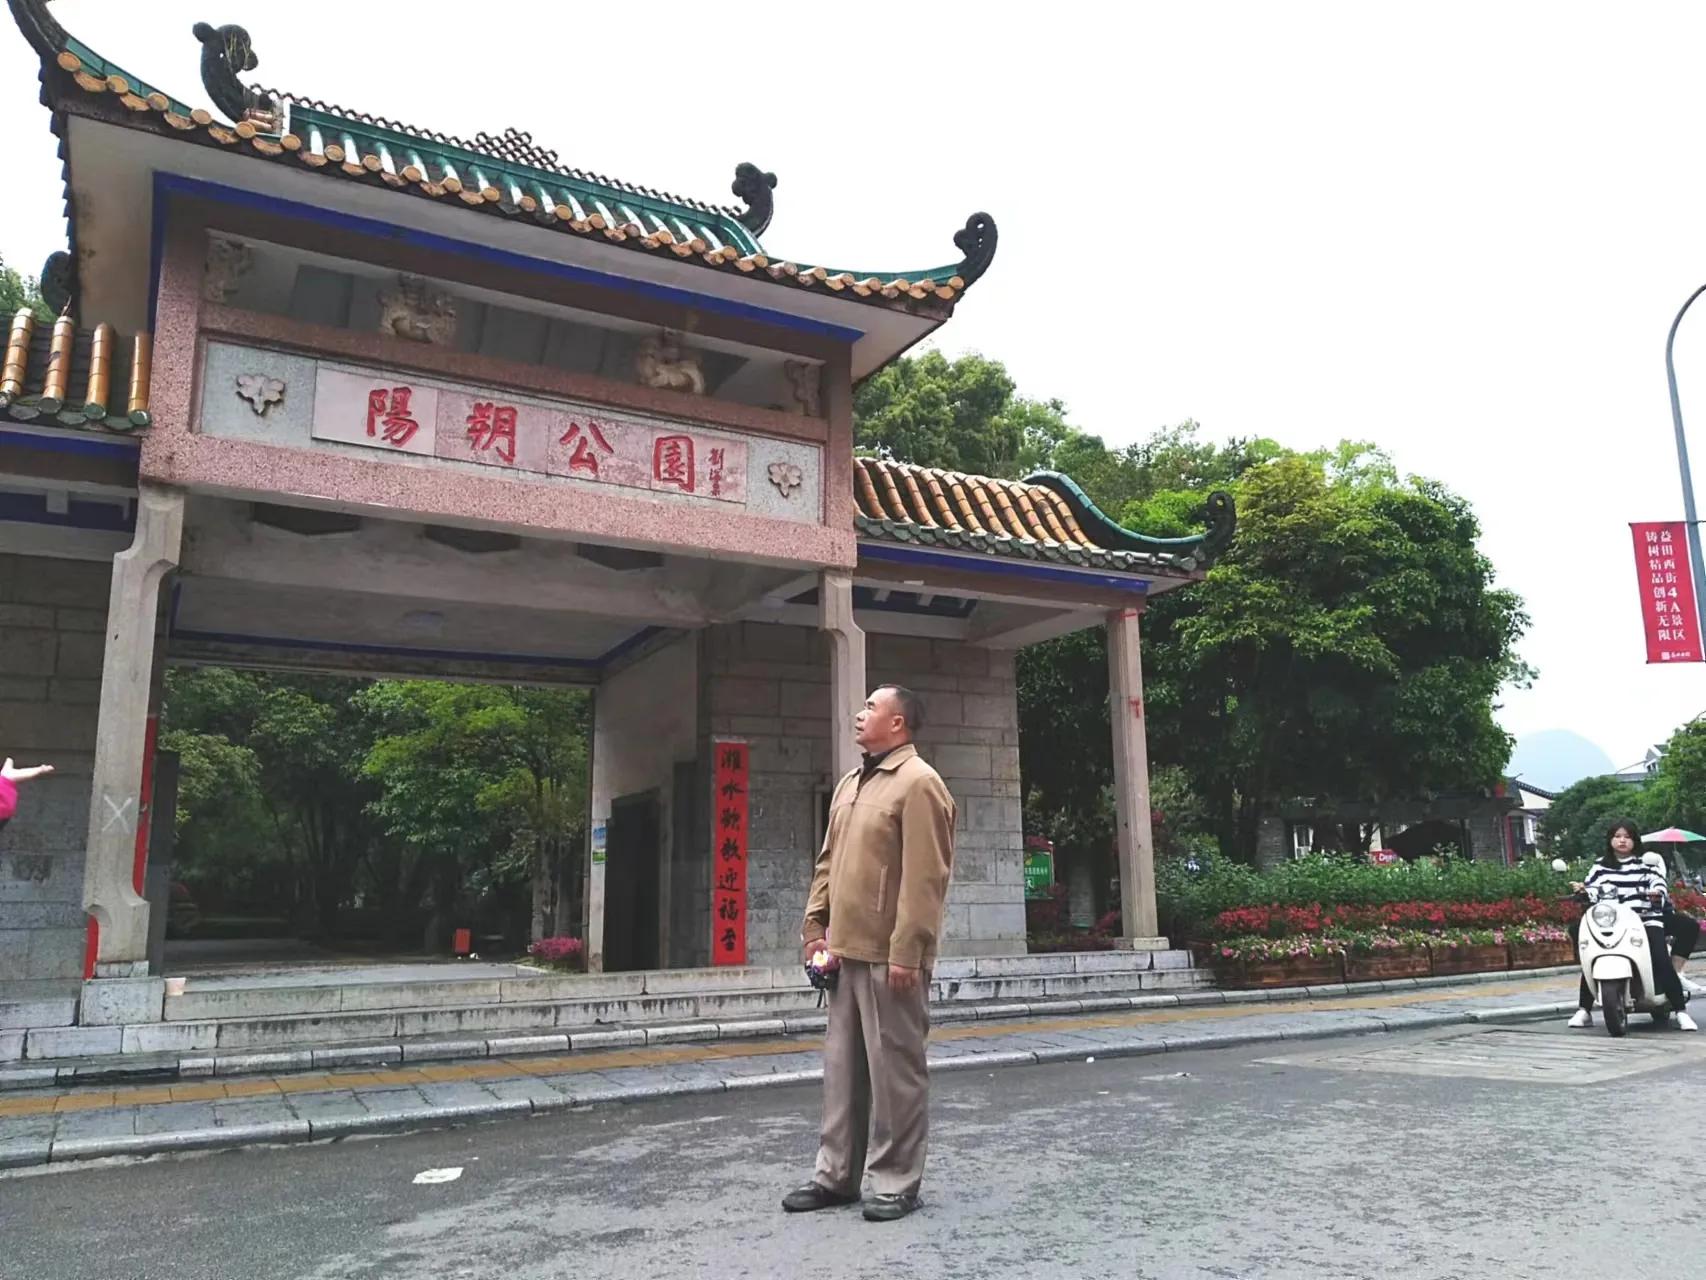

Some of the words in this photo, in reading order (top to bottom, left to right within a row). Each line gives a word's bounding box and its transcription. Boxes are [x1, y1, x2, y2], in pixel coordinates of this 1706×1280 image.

[366, 386, 695, 493] 陽朔公園
[1660, 530, 1686, 641] 益田西街4A景区
